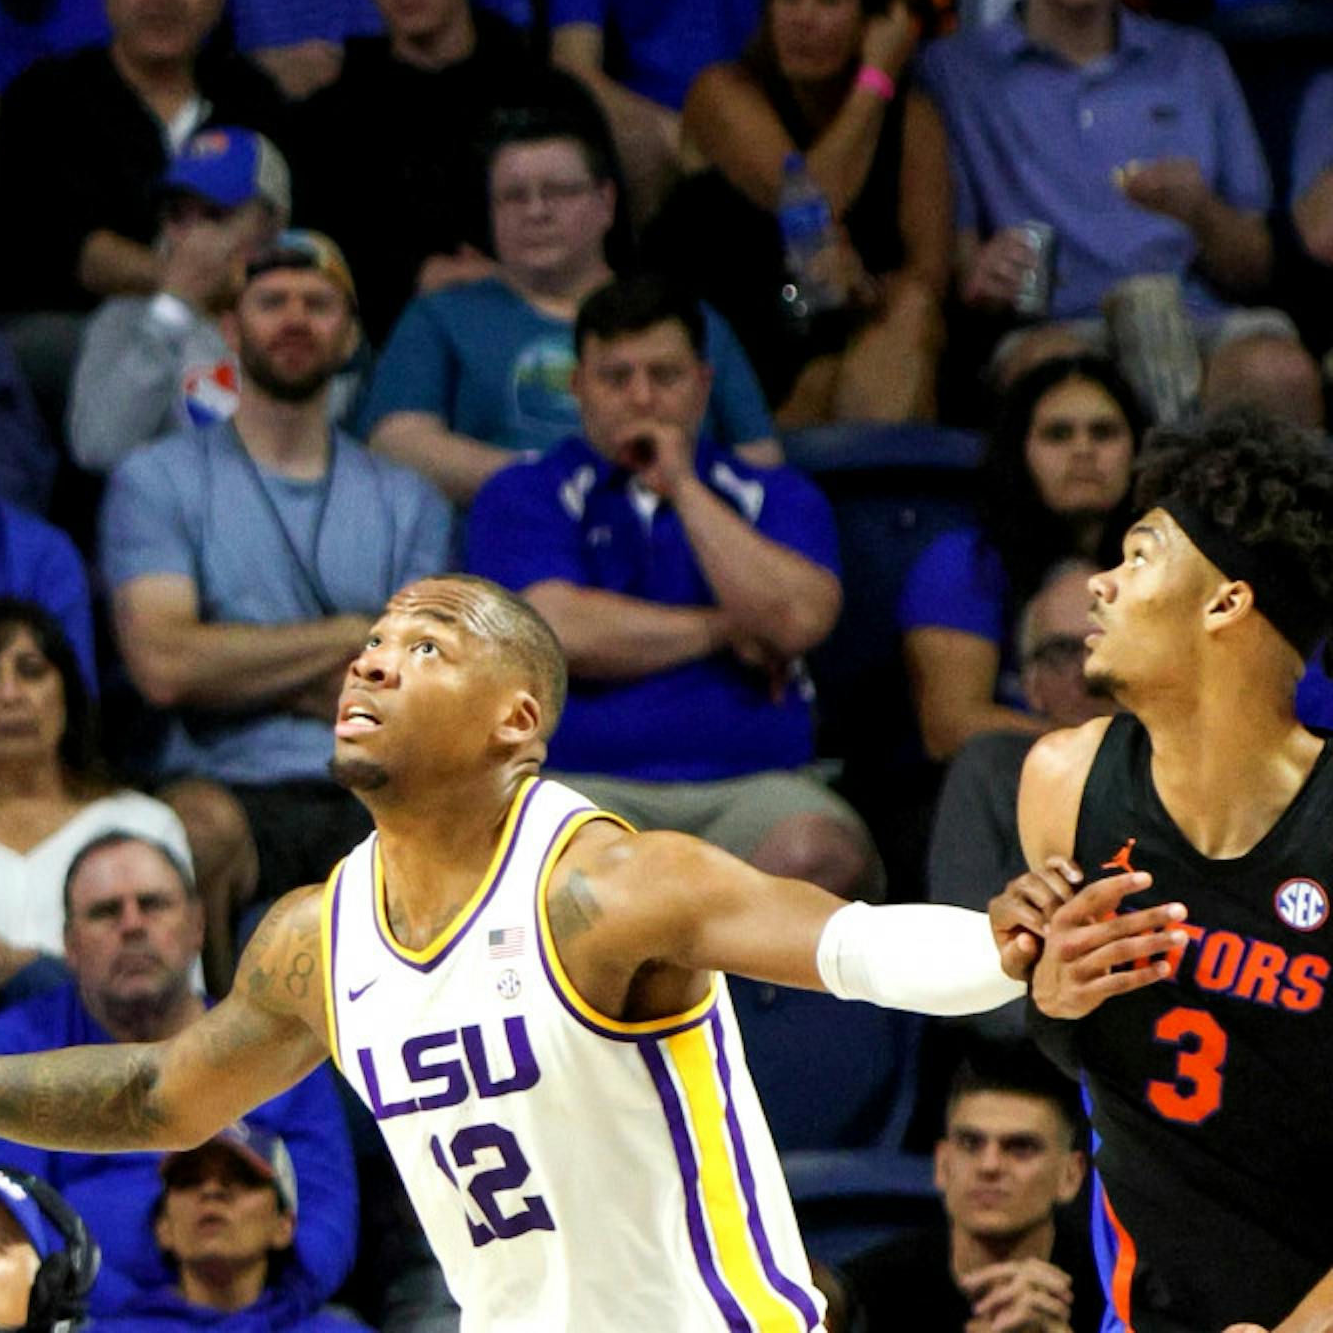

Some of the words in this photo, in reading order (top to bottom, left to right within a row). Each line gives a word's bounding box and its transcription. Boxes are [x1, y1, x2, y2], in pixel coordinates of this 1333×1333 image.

[1279, 882, 1326, 928] SEC
[1133, 917, 1331, 1013] TORS
[356, 1015, 542, 1122] LSU
[1146, 1006, 1229, 1126] 3
[429, 1123, 557, 1248] 12
